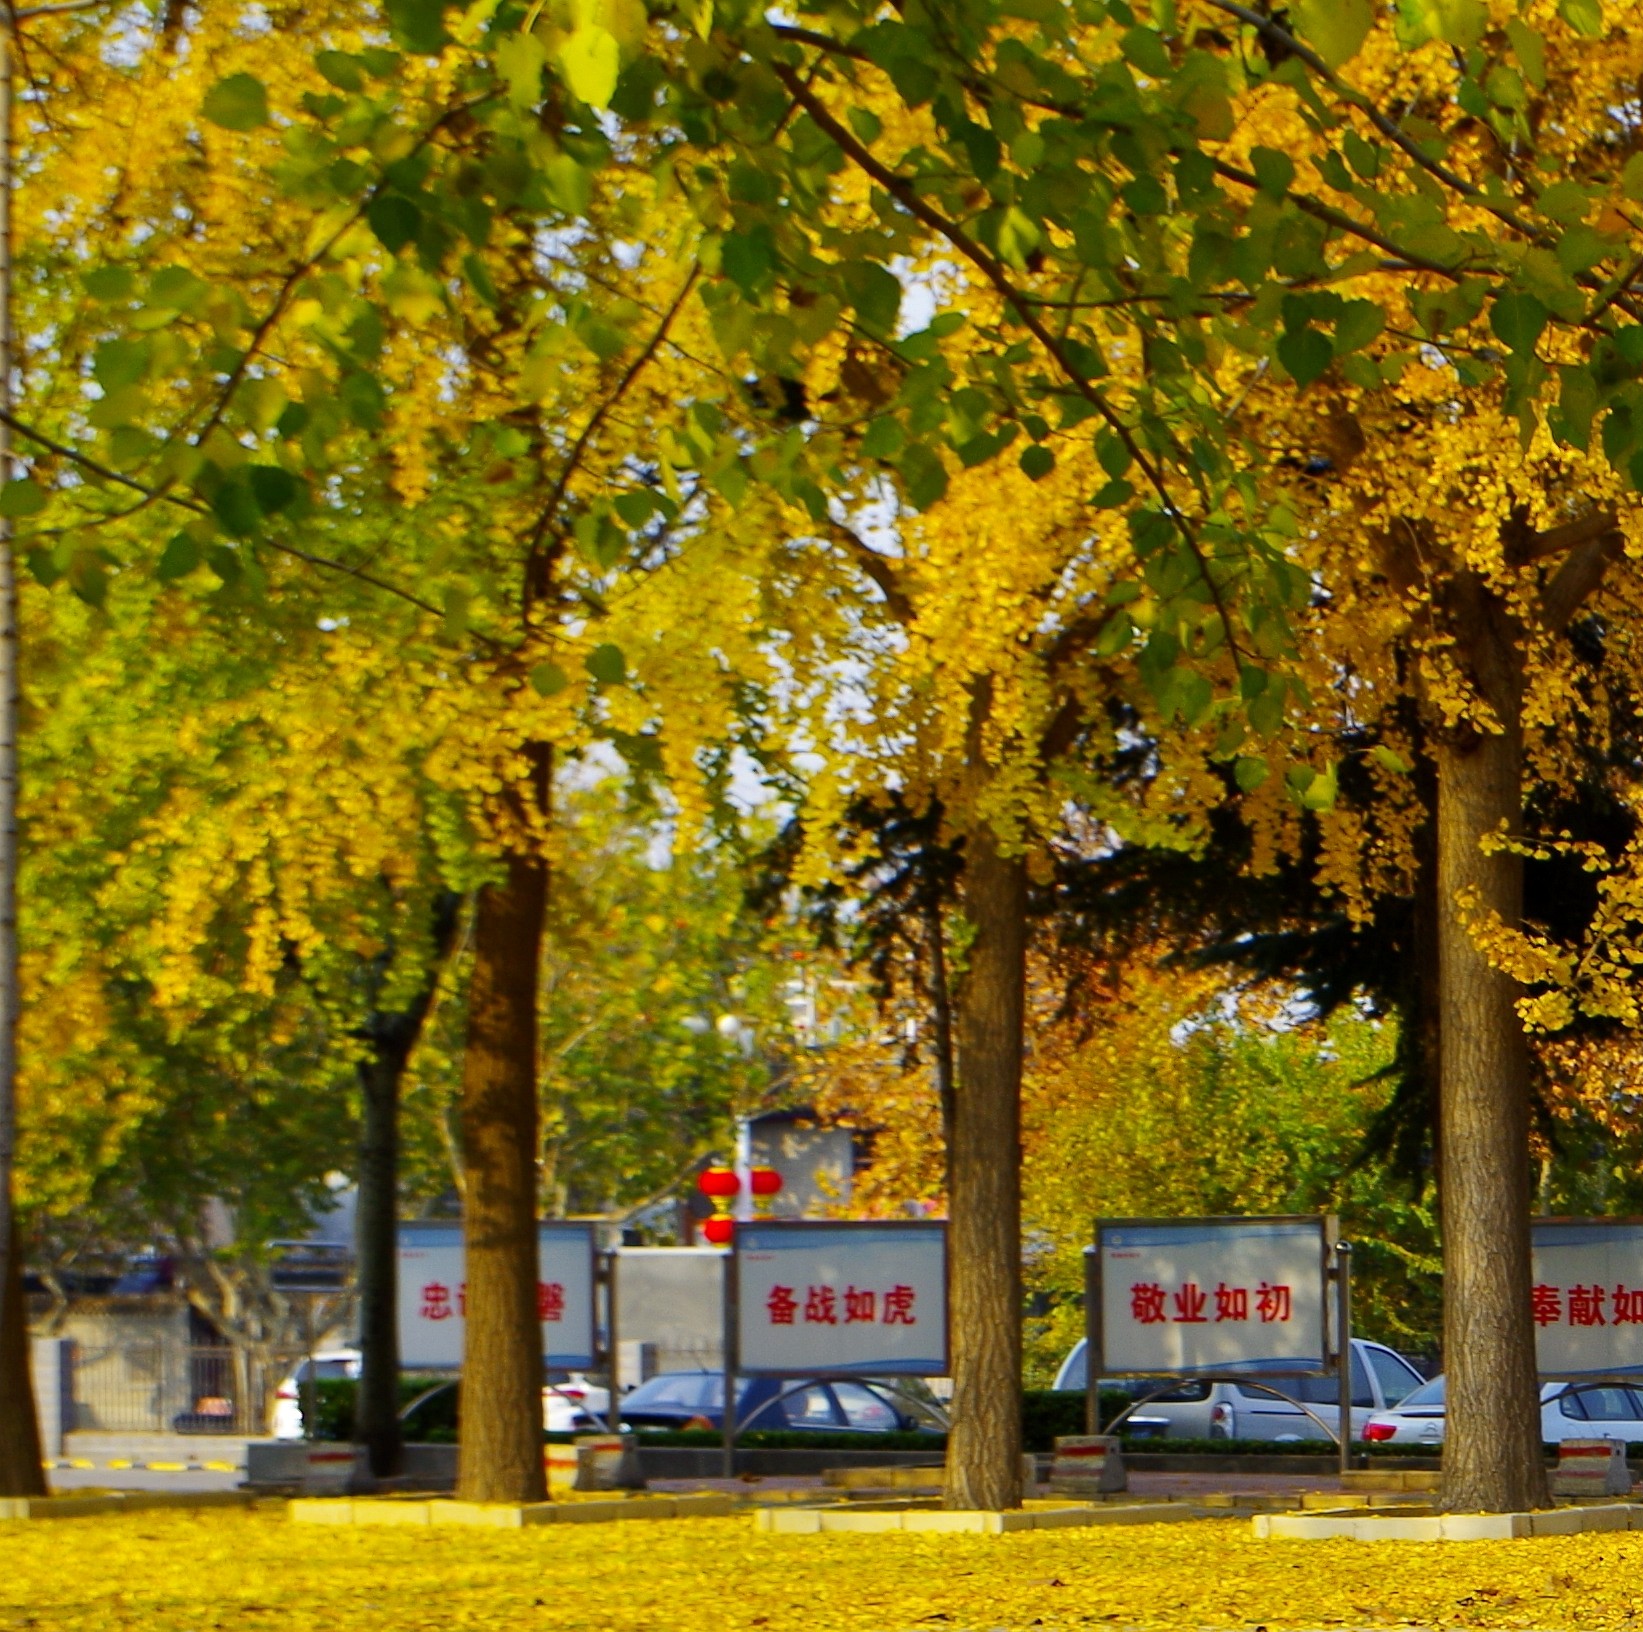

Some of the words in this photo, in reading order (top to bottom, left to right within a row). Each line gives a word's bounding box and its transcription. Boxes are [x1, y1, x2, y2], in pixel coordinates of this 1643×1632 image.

[419, 1281, 566, 1322] 忠磐
[767, 1285, 916, 1326] 备战如虎
[1130, 1282, 1292, 1325] 敬业如初
